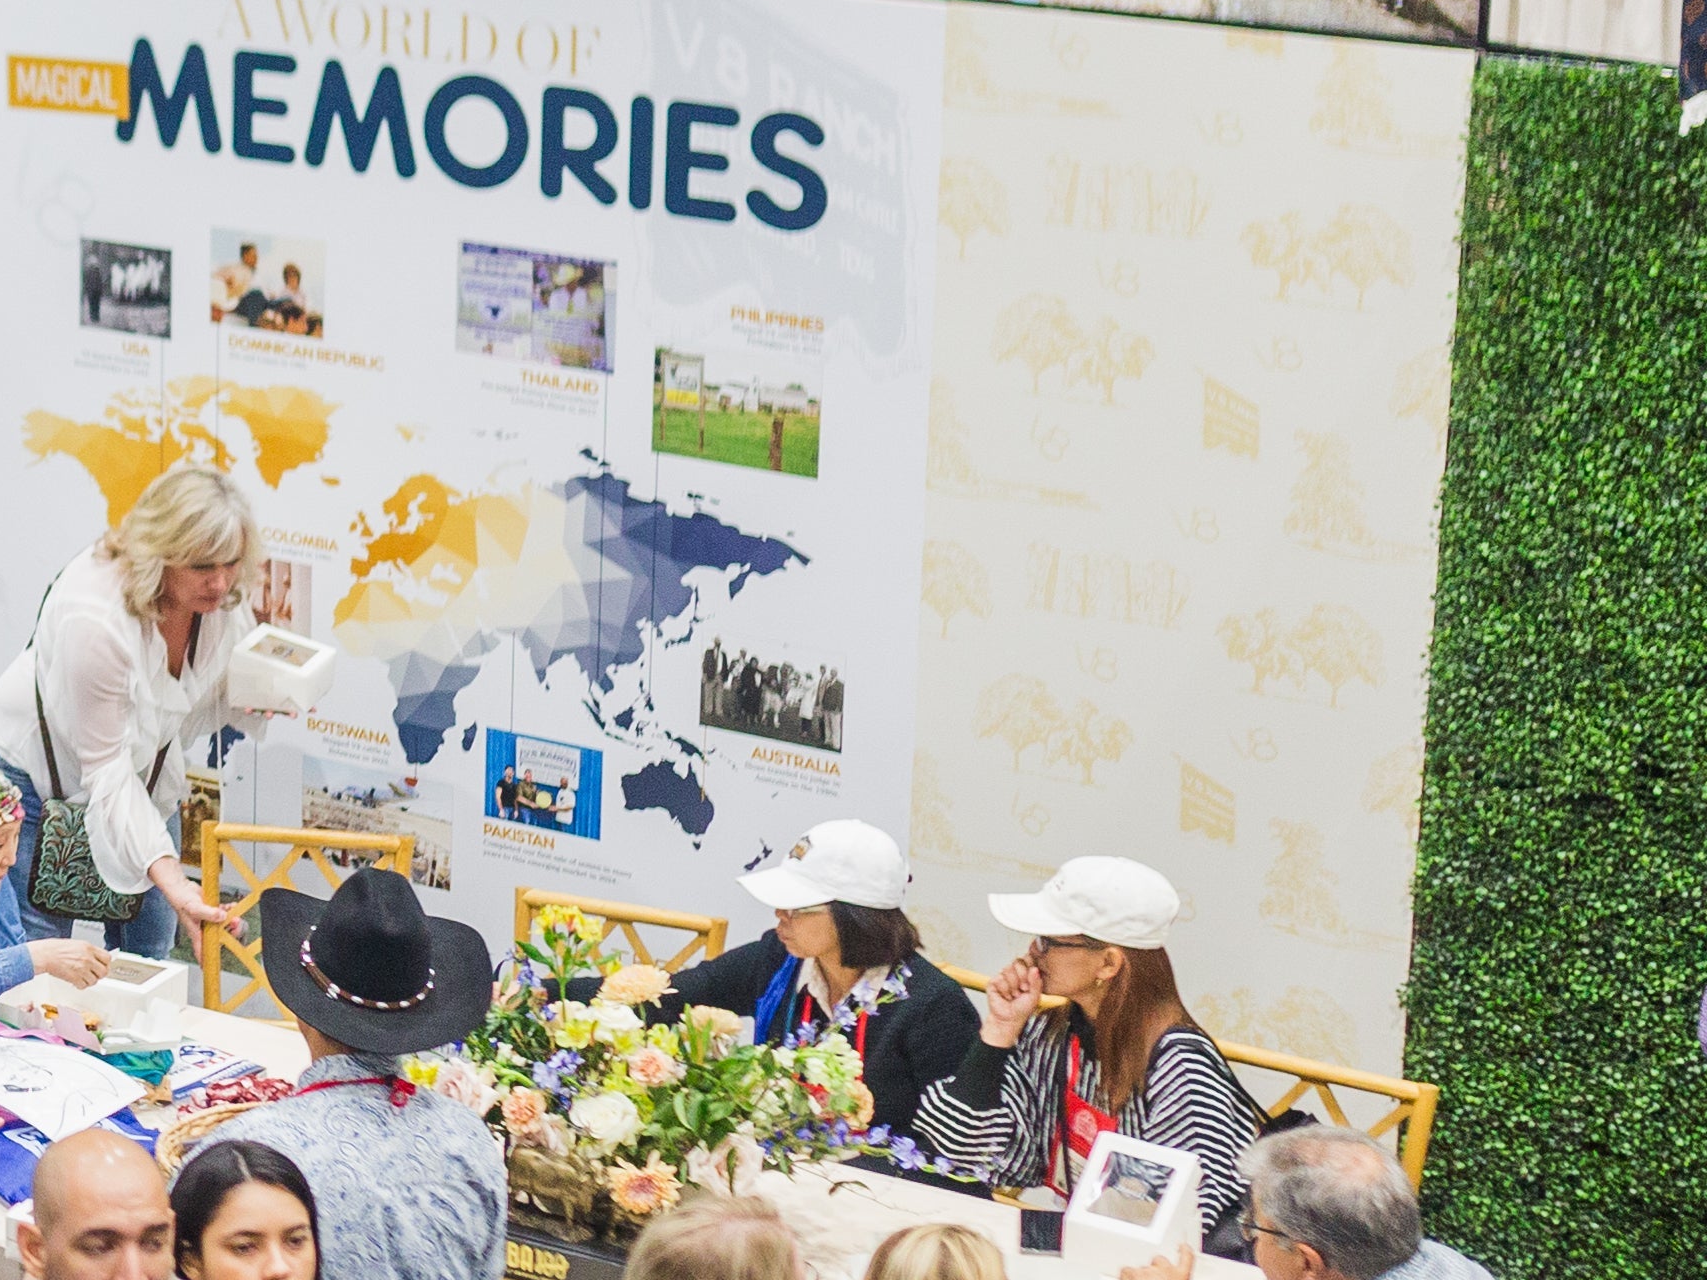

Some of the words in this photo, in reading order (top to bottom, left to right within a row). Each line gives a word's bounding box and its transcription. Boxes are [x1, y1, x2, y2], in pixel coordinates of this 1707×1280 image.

[517, 22, 600, 77] OF
[15, 64, 118, 111] MAGICAL
[115, 36, 828, 231] MEMORIES
[730, 304, 825, 332] PHILIPPINES
[122, 341, 150, 357] USA
[228, 334, 314, 360] DOMINICAN
[316, 347, 385, 371] REPUBLIC
[520, 368, 599, 396] THAILAND
[261, 526, 338, 552] COLOMBIA
[307, 717, 391, 746] BOTSWANA
[751, 746, 841, 776] AUSTRALIA
[483, 823, 555, 849] PAKISTAN
